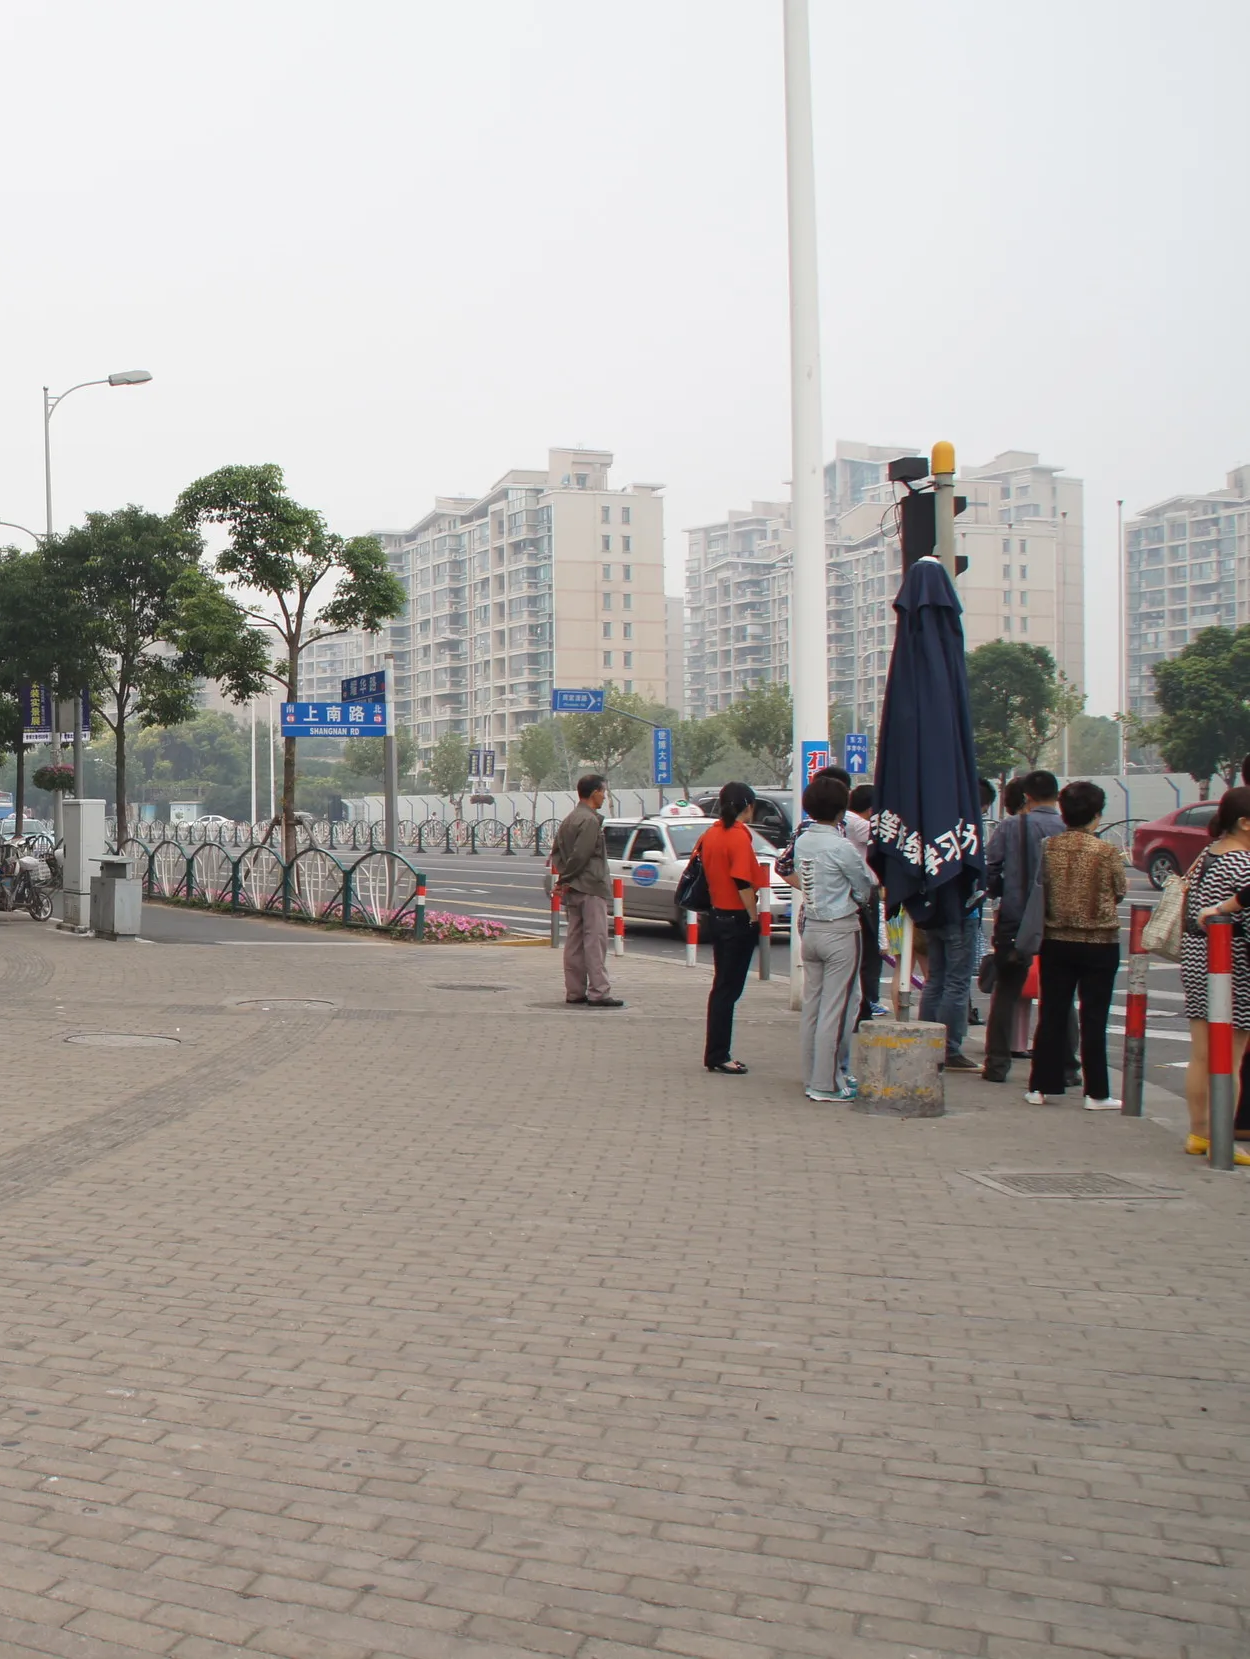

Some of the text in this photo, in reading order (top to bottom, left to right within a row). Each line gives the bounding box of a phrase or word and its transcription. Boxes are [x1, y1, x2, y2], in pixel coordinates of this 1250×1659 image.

[286, 704, 382, 722] 南 上南路 北
[309, 727, 360, 735] SHANGNAN RD
